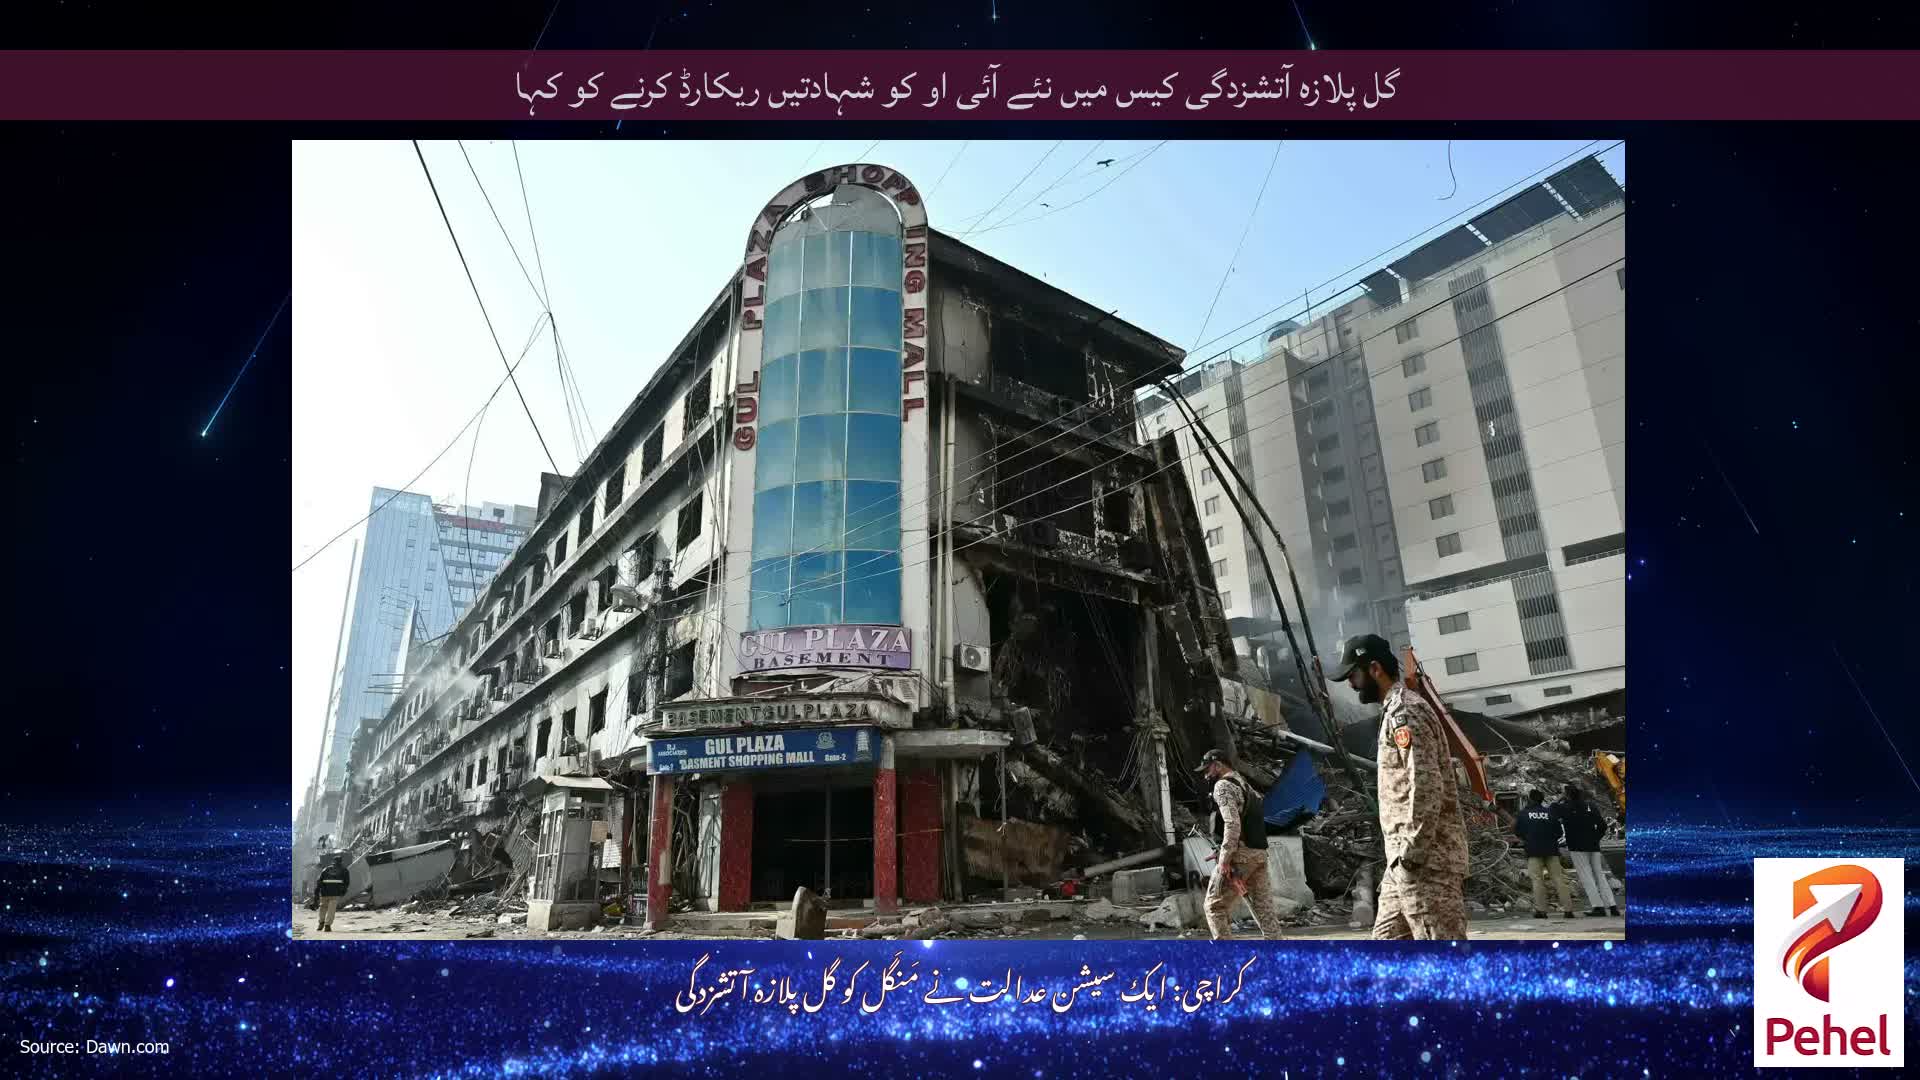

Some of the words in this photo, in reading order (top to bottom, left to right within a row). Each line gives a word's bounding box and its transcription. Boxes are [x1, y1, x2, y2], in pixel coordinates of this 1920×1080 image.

[742, 203, 789, 331] PLAZA
[903, 308, 926, 422] MALL
[734, 371, 759, 451] GUL
[740, 631, 793, 658] GUL
[804, 628, 910, 652] PLAZA
[753, 652, 891, 670] BASEMENT
[705, 738, 734, 755] GUL
[736, 734, 785, 753] PLAZA
[728, 752, 784, 767] SHOPPING
[785, 751, 815, 763] MALL
[1528, 812, 1549, 820] POLICE
